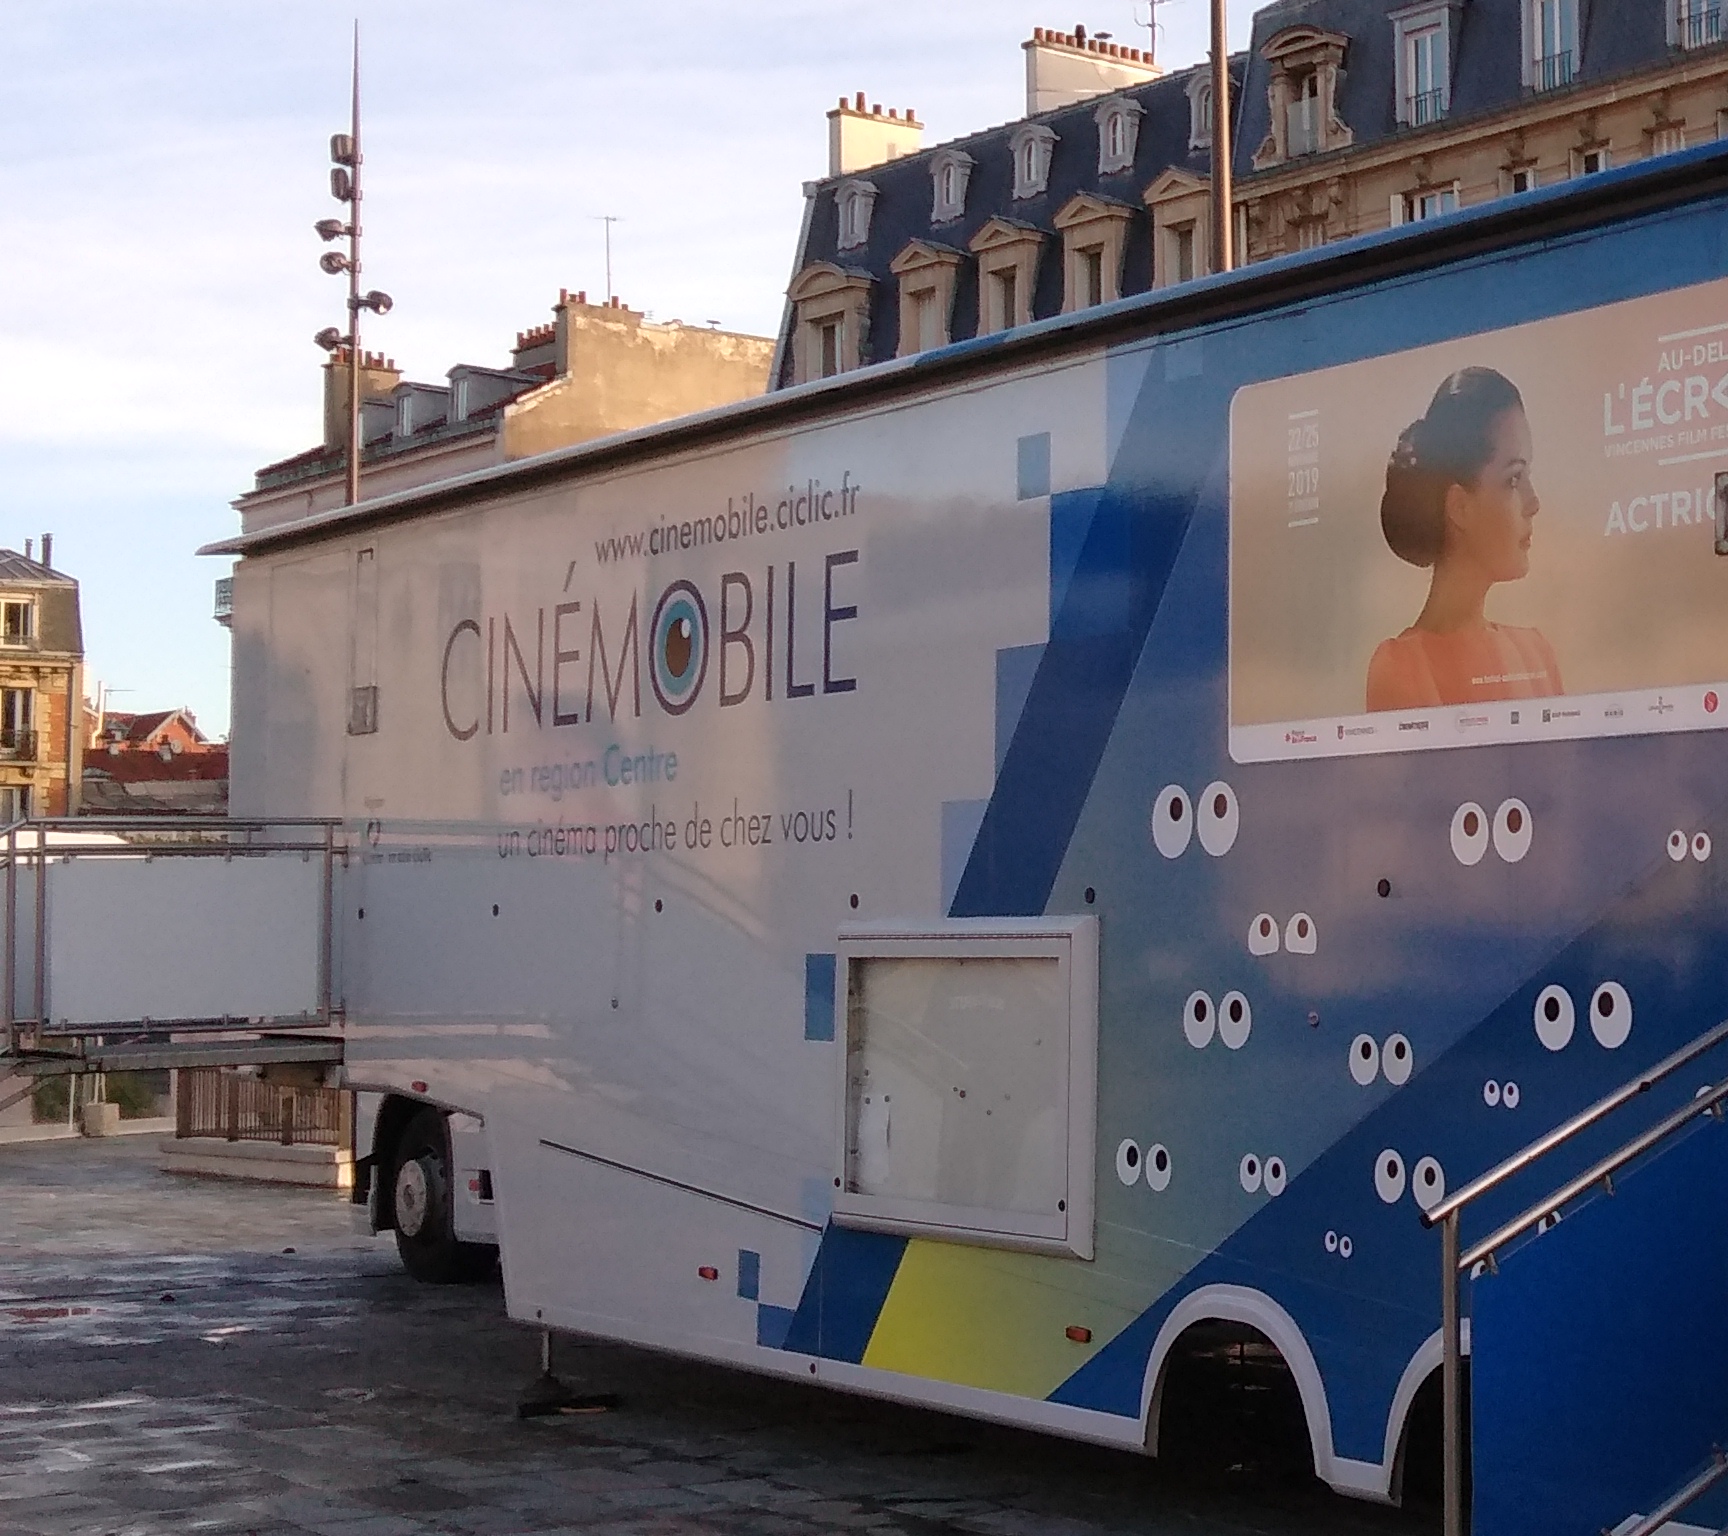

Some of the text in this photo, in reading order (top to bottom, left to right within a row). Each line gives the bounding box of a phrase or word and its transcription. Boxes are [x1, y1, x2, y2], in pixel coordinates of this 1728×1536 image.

[1604, 435, 1674, 457] VINCENNES
[1678, 429, 1707, 445] FILM
[1288, 467, 1318, 497] 2019
[594, 471, 861, 565] www.cinemobile.ciclic.fr
[441, 549, 859, 742] CINÉMOBILE
[500, 768, 523, 796] en
[603, 743, 678, 787] Centre
[498, 830, 520, 859] un
[527, 816, 596, 857] cinéma
[605, 803, 677, 865] proche
[684, 801, 712, 849] de
[720, 796, 772, 848] chez
[780, 808, 836, 842] vous
